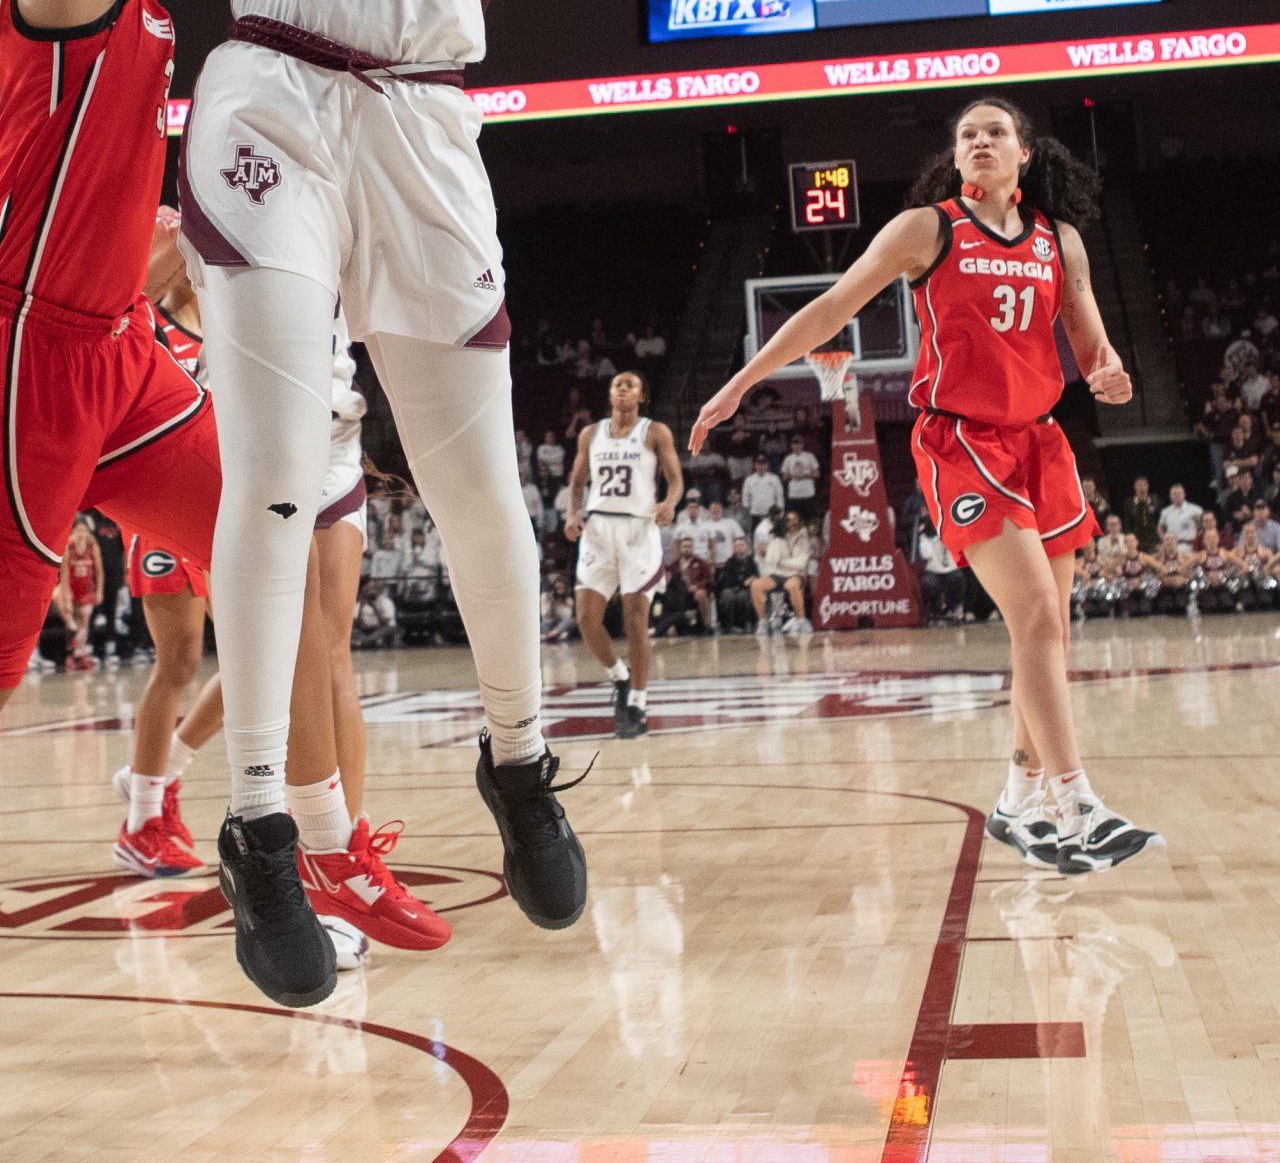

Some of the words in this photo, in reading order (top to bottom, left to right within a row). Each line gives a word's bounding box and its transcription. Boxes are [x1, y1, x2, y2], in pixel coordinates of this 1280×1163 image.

[1066, 39, 1155, 67] WELLS
[1160, 32, 1247, 60] FARGO
[824, 58, 910, 86] WELLS
[915, 52, 1001, 79] FARGO
[588, 77, 673, 104] WELLS
[676, 71, 760, 98] FARGO
[814, 168, 849, 188] 1:48
[806, 189, 845, 223] 24
[959, 257, 1053, 283] GEORGIA
[990, 284, 1035, 333] 31
[598, 465, 632, 497] 23
[830, 554, 894, 574] WELLS
[832, 574, 896, 593] FARGO
[244, 769, 275, 777] adidas
